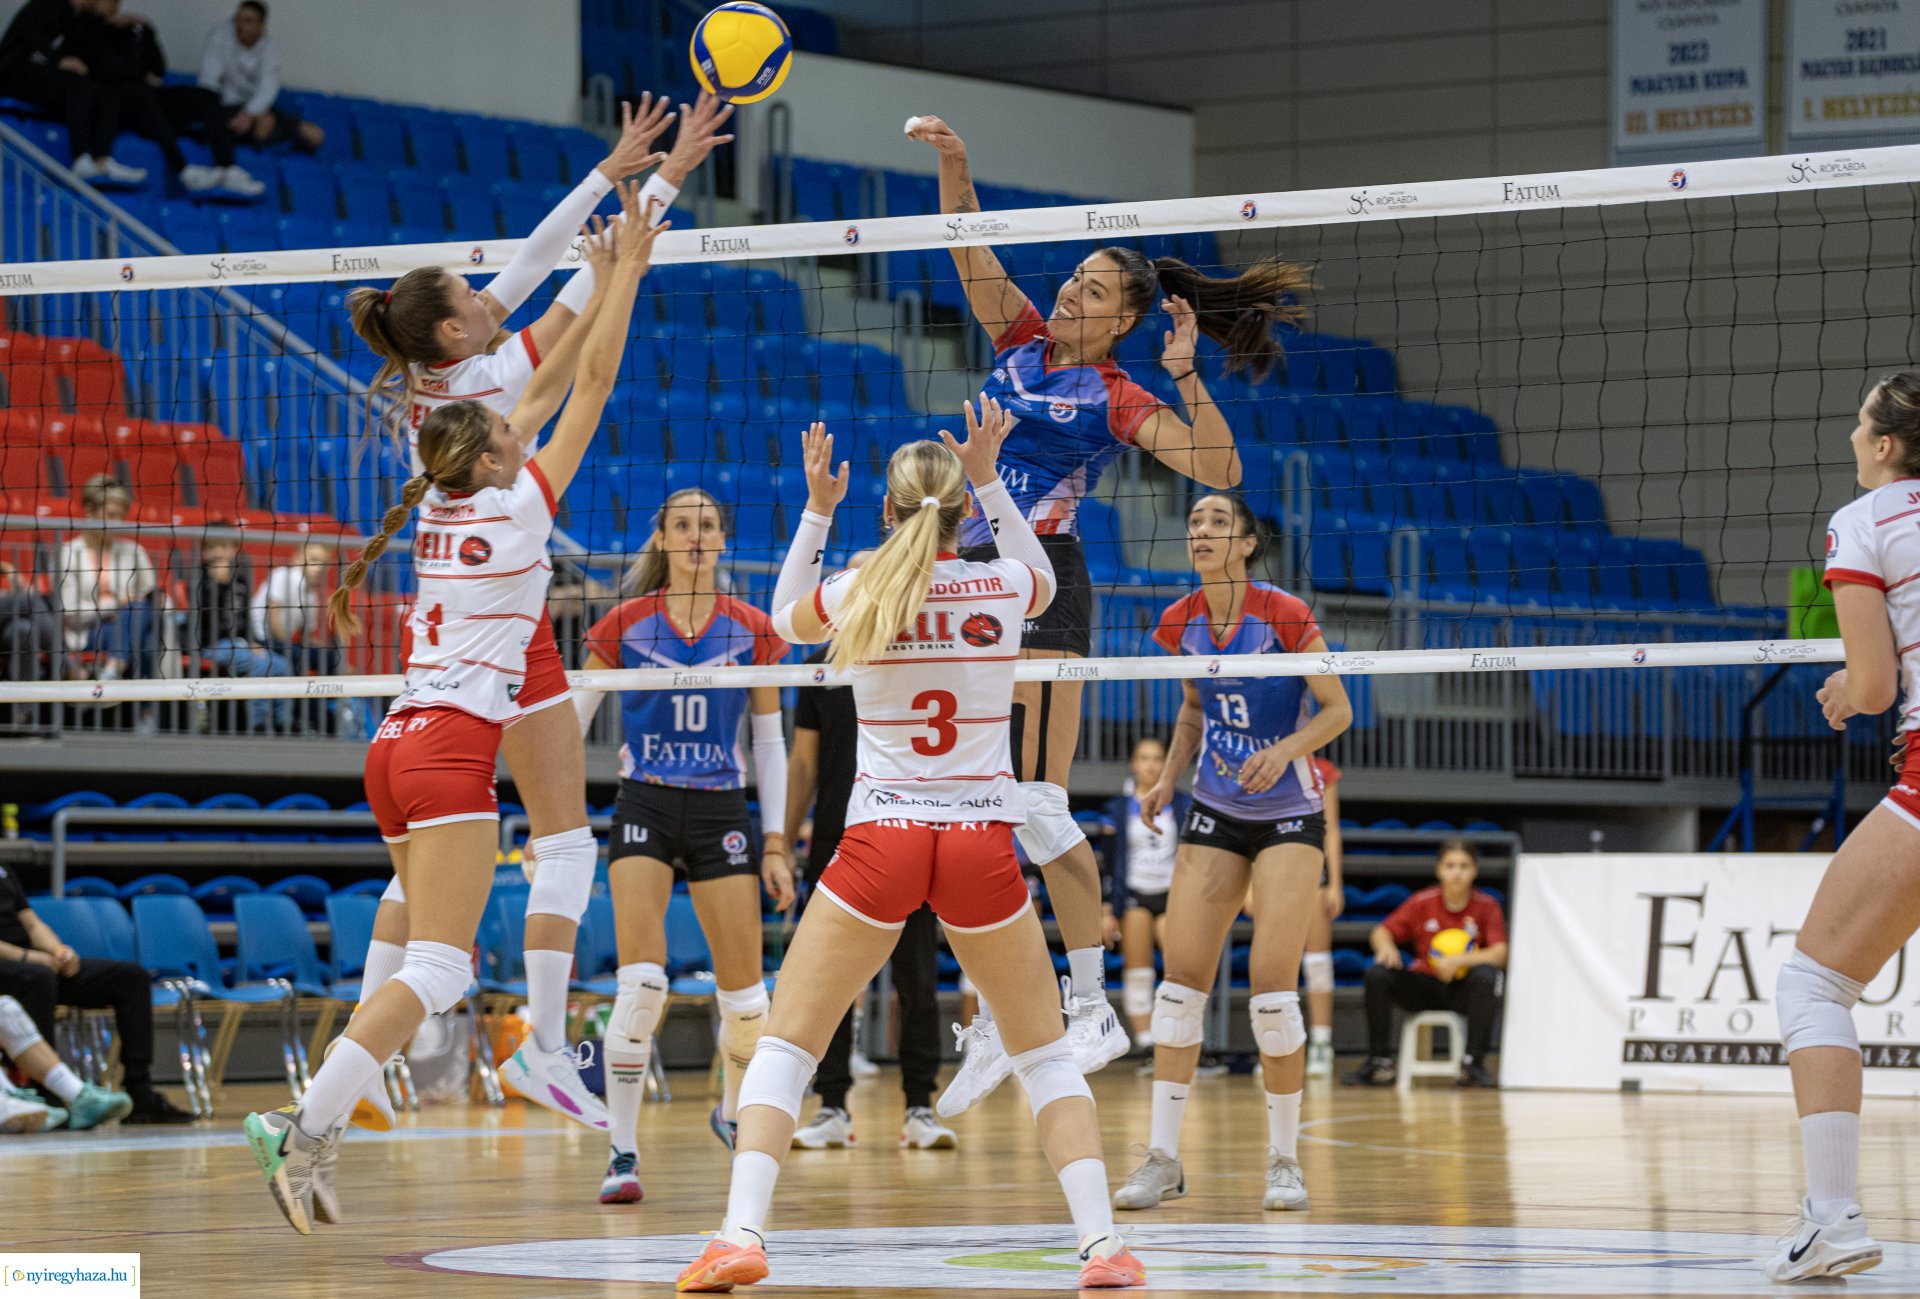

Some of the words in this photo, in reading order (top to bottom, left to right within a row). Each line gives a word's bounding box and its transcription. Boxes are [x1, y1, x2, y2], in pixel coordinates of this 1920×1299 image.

[1502, 182, 1560, 201] FATUM
[1086, 211, 1140, 230] FATUM
[700, 234, 751, 253] FATUM
[332, 254, 380, 272] FATUM
[0, 273, 33, 288] ATUM
[928, 576, 1004, 595] SDÓTTIR
[1057, 662, 1099, 677] FATUM
[1470, 653, 1517, 668] FATUM
[306, 680, 344, 694] FATUM
[672, 672, 713, 686] FATUM
[671, 694, 708, 732] 10
[1216, 693, 1250, 729] 13
[910, 689, 958, 757] 3
